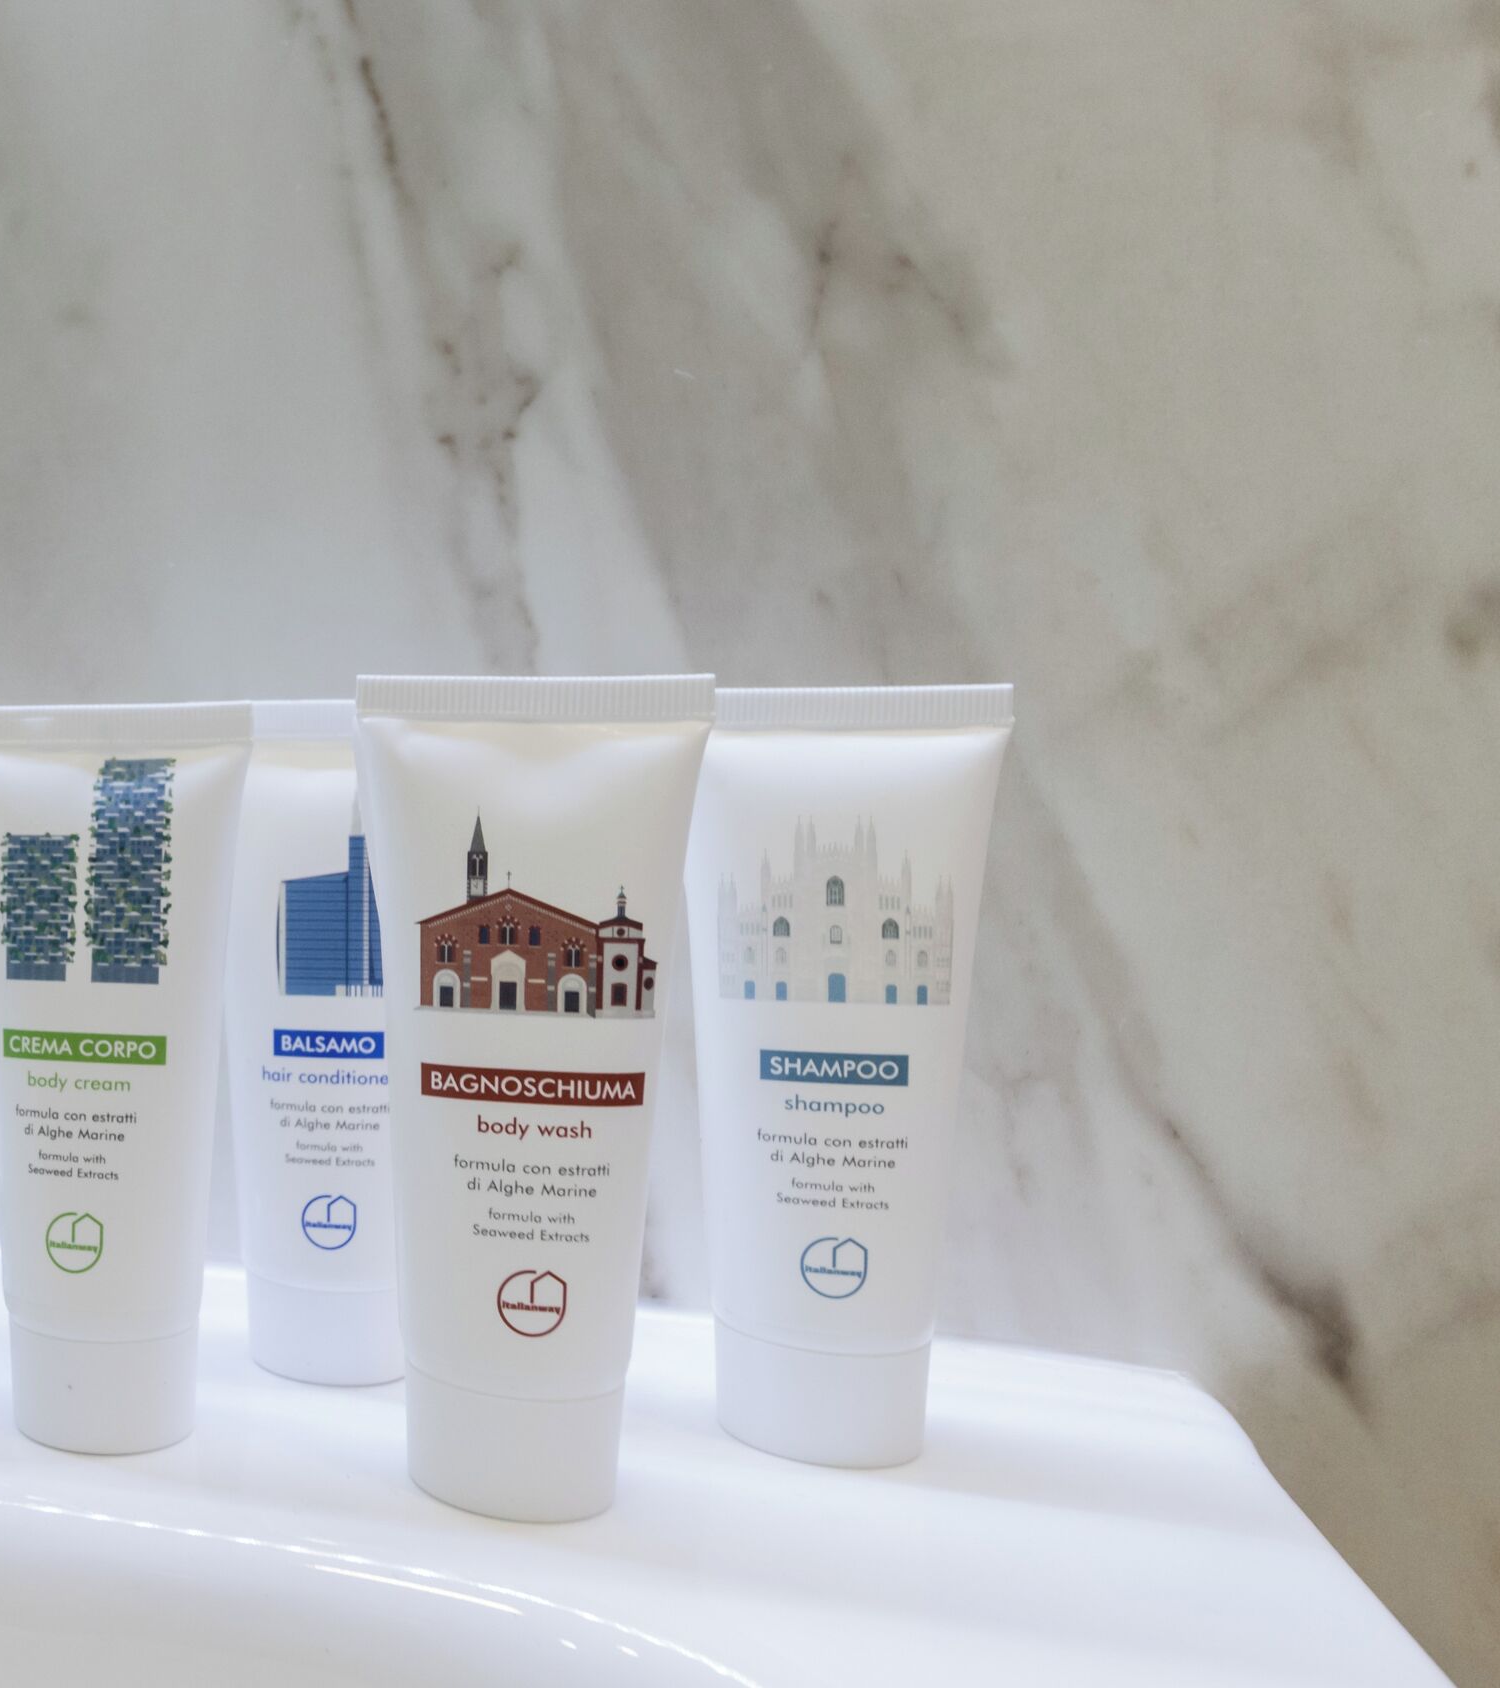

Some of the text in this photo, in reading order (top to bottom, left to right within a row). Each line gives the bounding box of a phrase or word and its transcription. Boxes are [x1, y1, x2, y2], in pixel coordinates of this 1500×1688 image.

[9, 1035, 157, 1059] CREMA CORPO
[281, 1035, 376, 1054] BALSAMO
[262, 1066, 388, 1086] hair conditione
[770, 1056, 899, 1080] SHAMPOO
[27, 1070, 131, 1092] body cream
[430, 1070, 636, 1100] BAGNOSCHIUMA
[15, 1104, 137, 1124] formula con estratti
[270, 1099, 316, 1113] formula
[321, 1103, 343, 1114] con
[785, 1094, 885, 1117] shampoo
[24, 1124, 125, 1142] di Alghe Marine
[280, 1117, 380, 1134] di Alghe Marine
[477, 1114, 592, 1140] body wash
[296, 1141, 363, 1153] formula with
[757, 1128, 908, 1150] formula con estratti
[38, 1150, 106, 1164] formula with
[285, 1154, 375, 1168] Seaweed Extracts
[453, 1153, 610, 1177] formula con estratti
[770, 1150, 896, 1169] di Alghe Marine
[28, 1163, 119, 1181] Seaweed Extracts
[467, 1177, 597, 1198] di Alghe Marine
[791, 1177, 875, 1193] formula with
[776, 1192, 889, 1211] Seaweed Extracts
[488, 1207, 575, 1225] formula with
[472, 1223, 590, 1243] Seaweed Extracts
